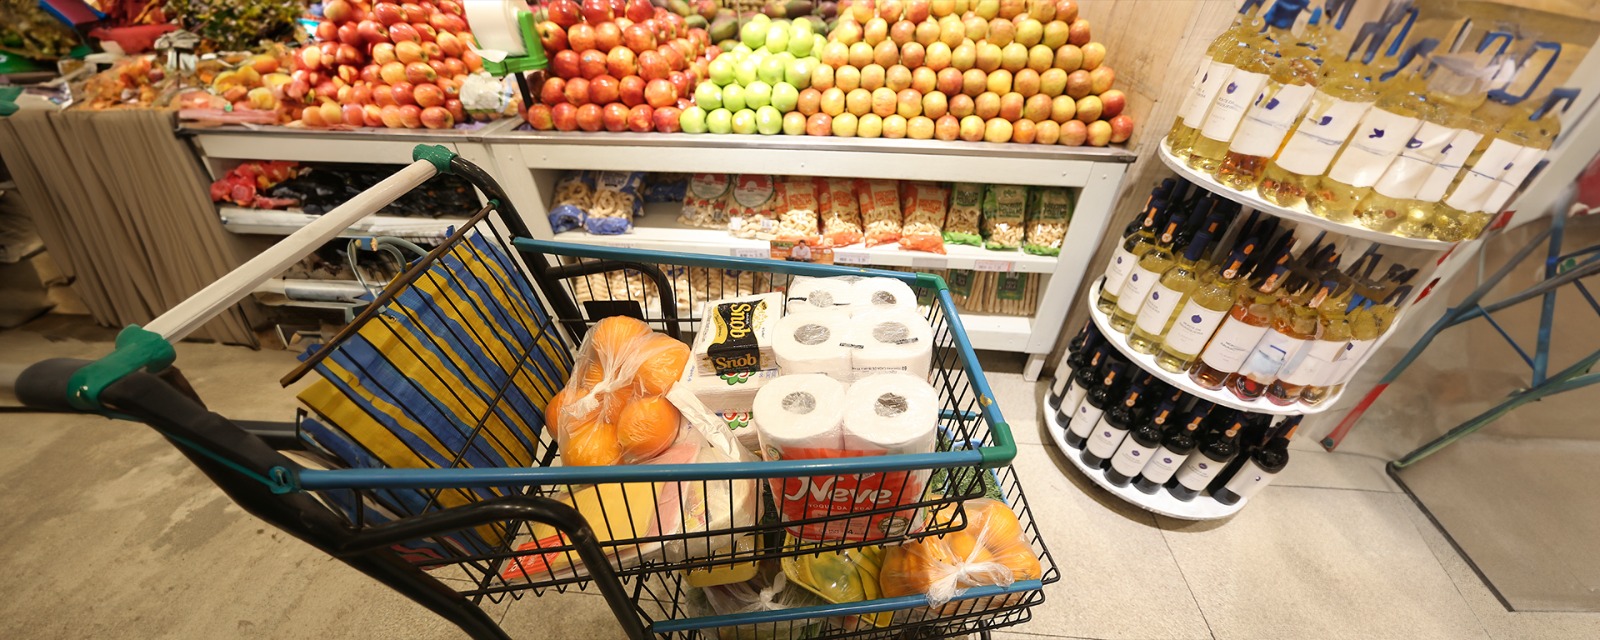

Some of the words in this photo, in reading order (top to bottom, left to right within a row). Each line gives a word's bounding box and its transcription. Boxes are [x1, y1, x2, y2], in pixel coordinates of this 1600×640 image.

[730, 303, 752, 338] Snob
[715, 353, 757, 370] Snob
[784, 476, 892, 504] Neve
